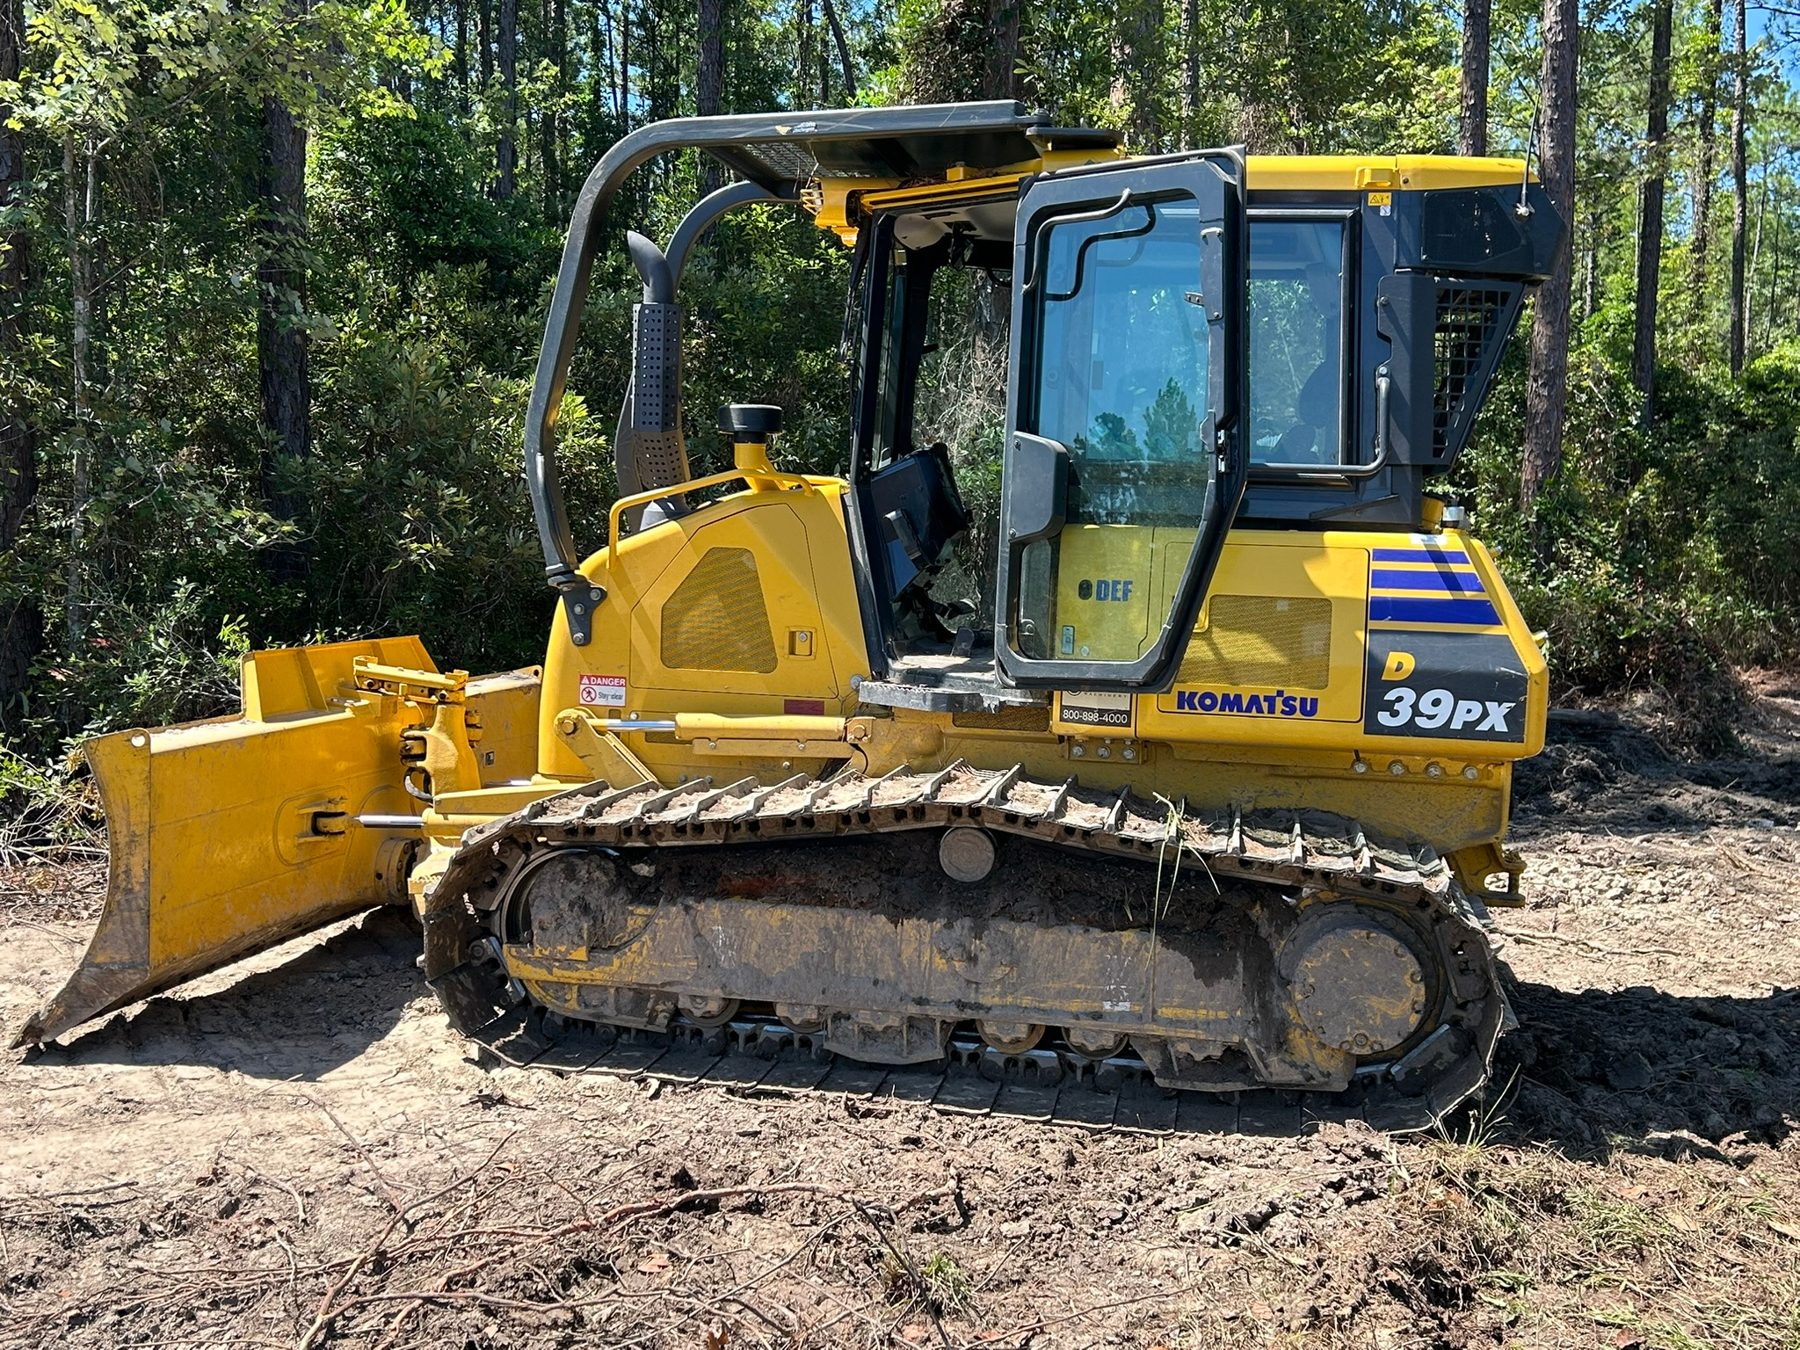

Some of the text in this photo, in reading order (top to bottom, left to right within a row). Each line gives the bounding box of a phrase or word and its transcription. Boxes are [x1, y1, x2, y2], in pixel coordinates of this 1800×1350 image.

[1095, 579, 1133, 602] DEF
[1381, 651, 1416, 681] D
[590, 676, 626, 686] DANGER
[1062, 709, 1128, 724] 800-898-4000
[1177, 689, 1319, 718] KOMATSU
[1377, 687, 1517, 732] 39PX
